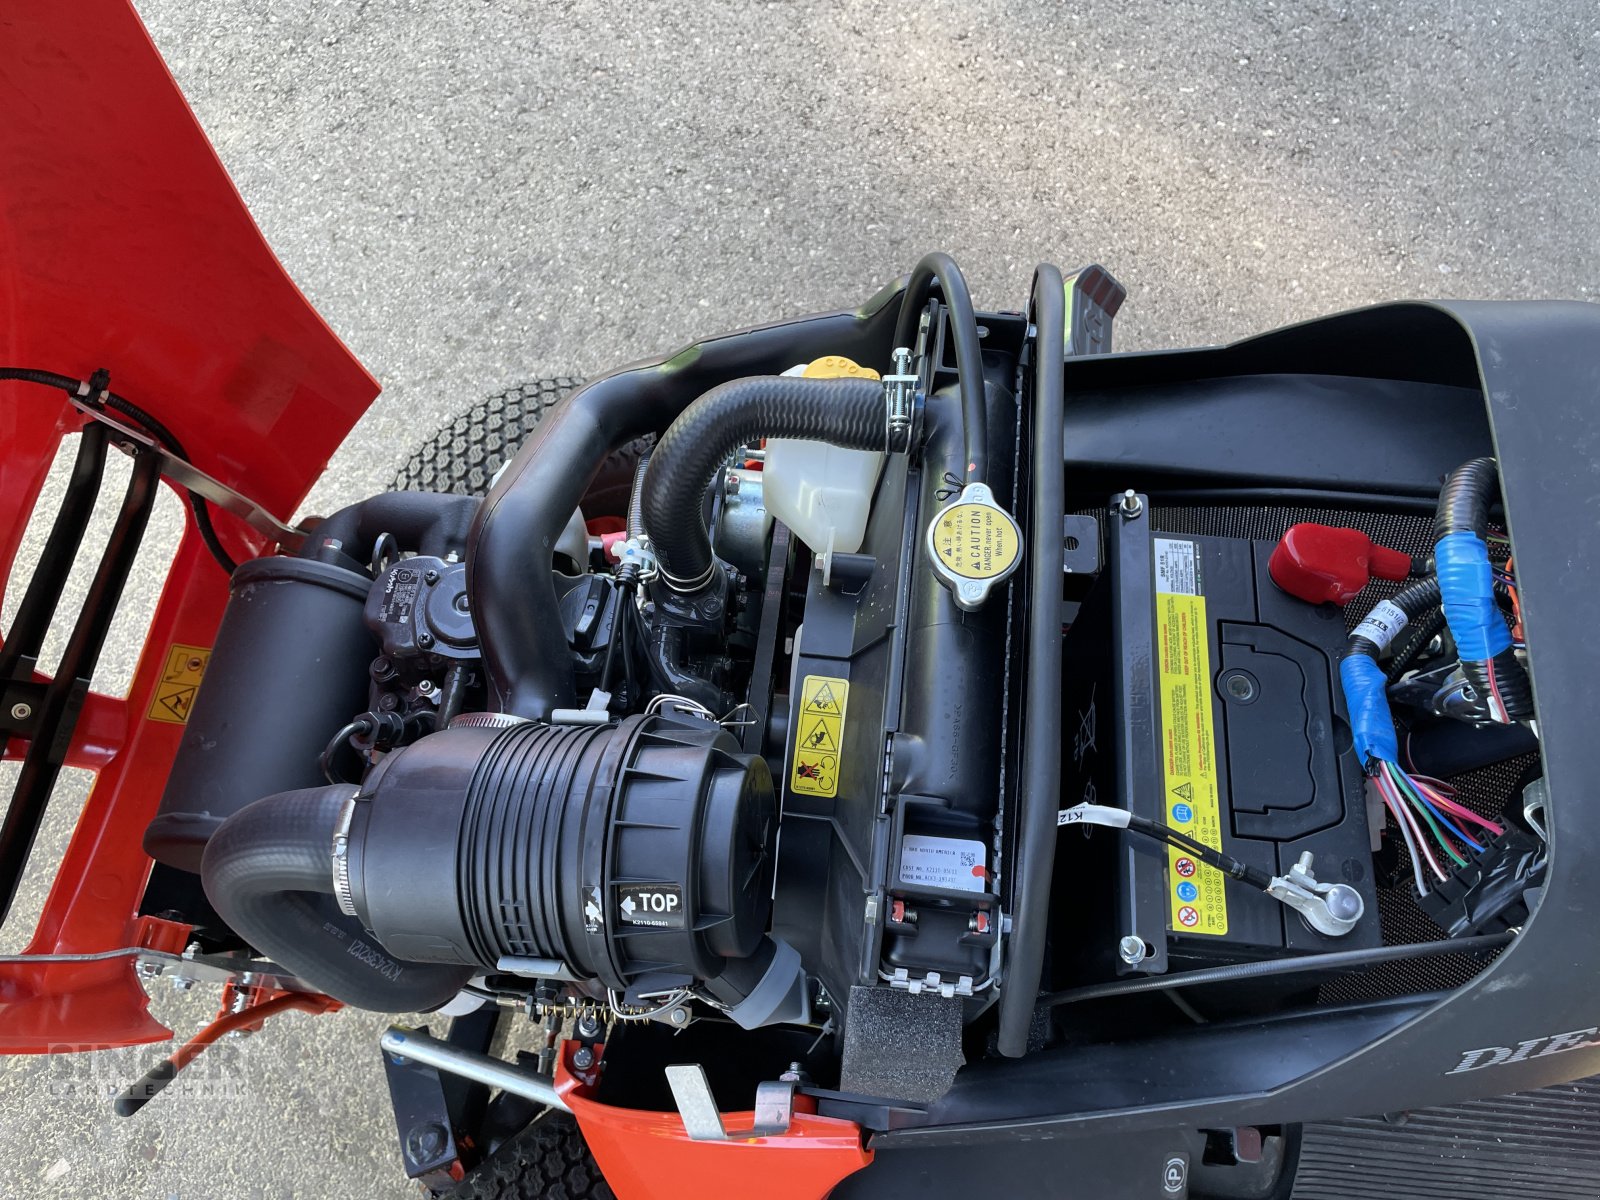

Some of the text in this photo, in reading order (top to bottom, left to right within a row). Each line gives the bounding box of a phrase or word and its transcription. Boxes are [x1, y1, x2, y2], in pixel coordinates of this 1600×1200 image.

[970, 511, 980, 558] CAUTION
[639, 893, 678, 912] TOP
[1445, 1027, 1600, 1074] DIE
